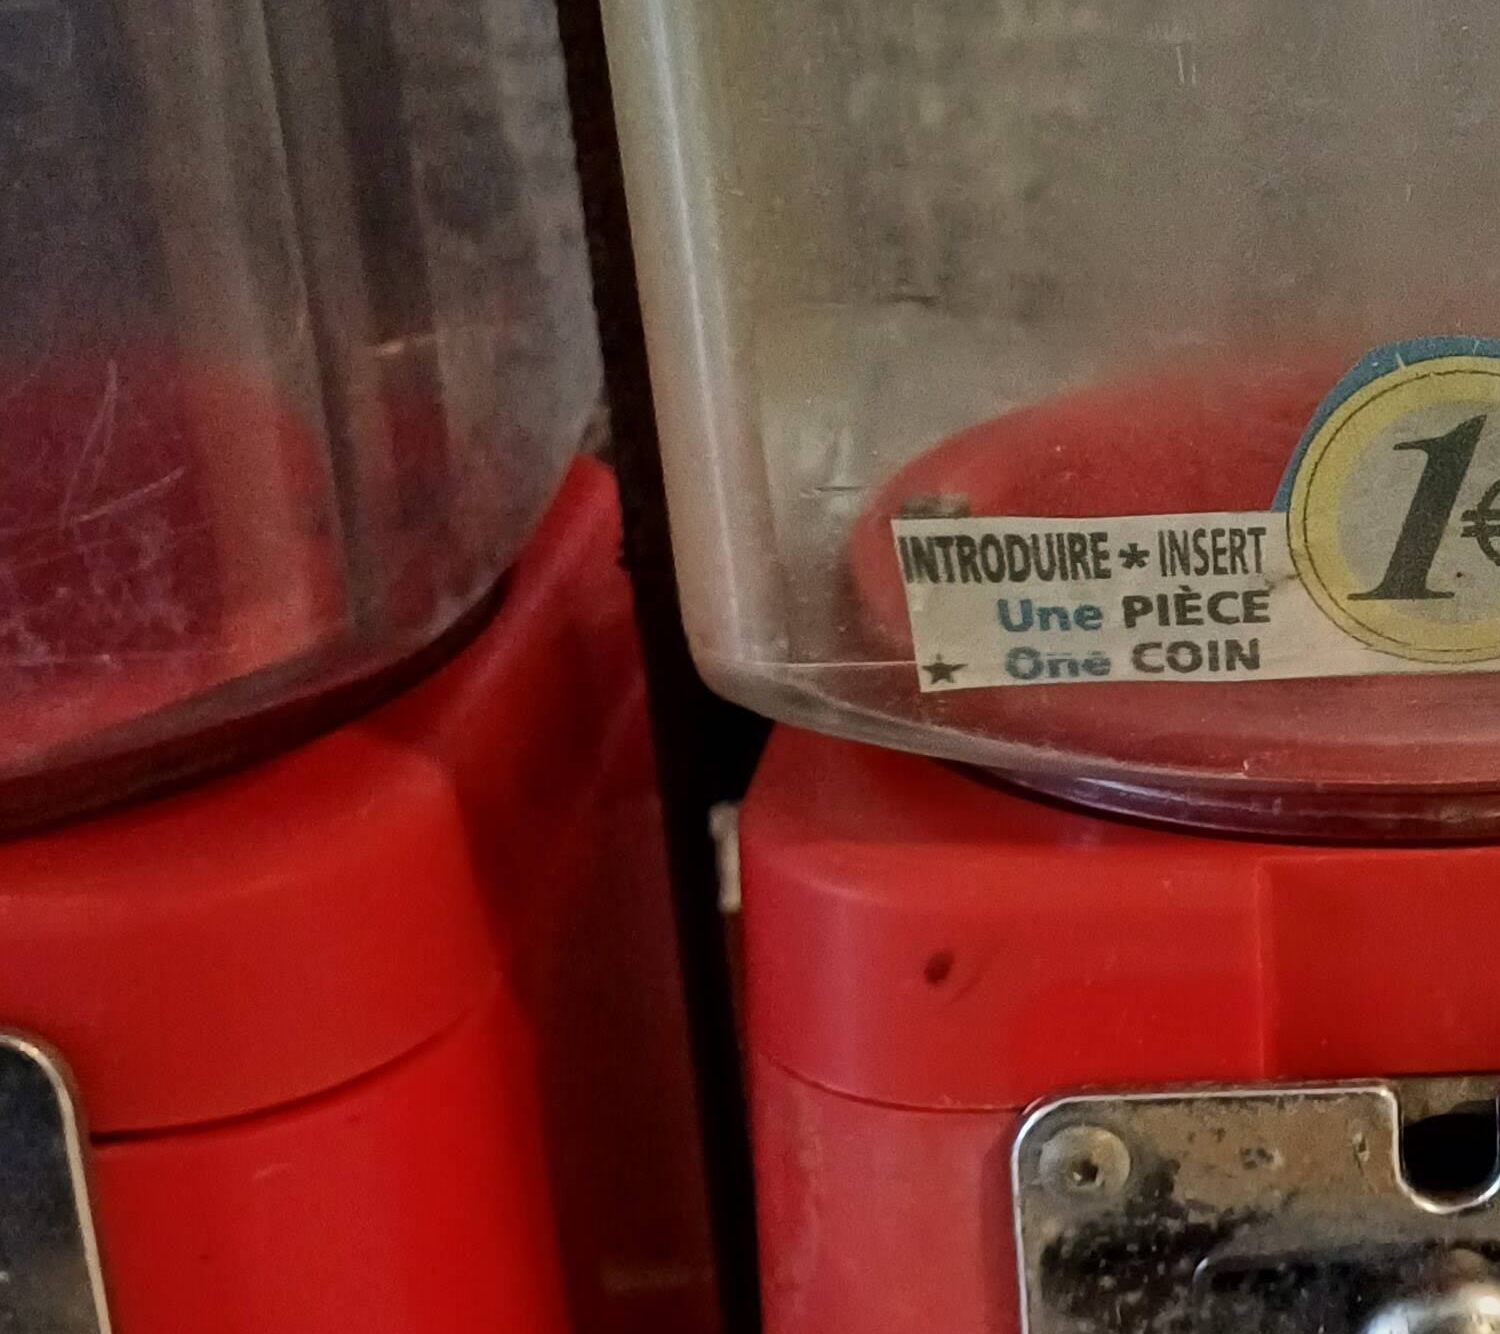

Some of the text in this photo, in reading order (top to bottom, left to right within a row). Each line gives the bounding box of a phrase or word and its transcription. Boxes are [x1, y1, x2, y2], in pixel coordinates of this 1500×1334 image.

[898, 527, 1267, 584] INTRODUIRE INSERT
[998, 584, 1272, 633] Une PIÈCE
[1004, 637, 1262, 681] One COIN
